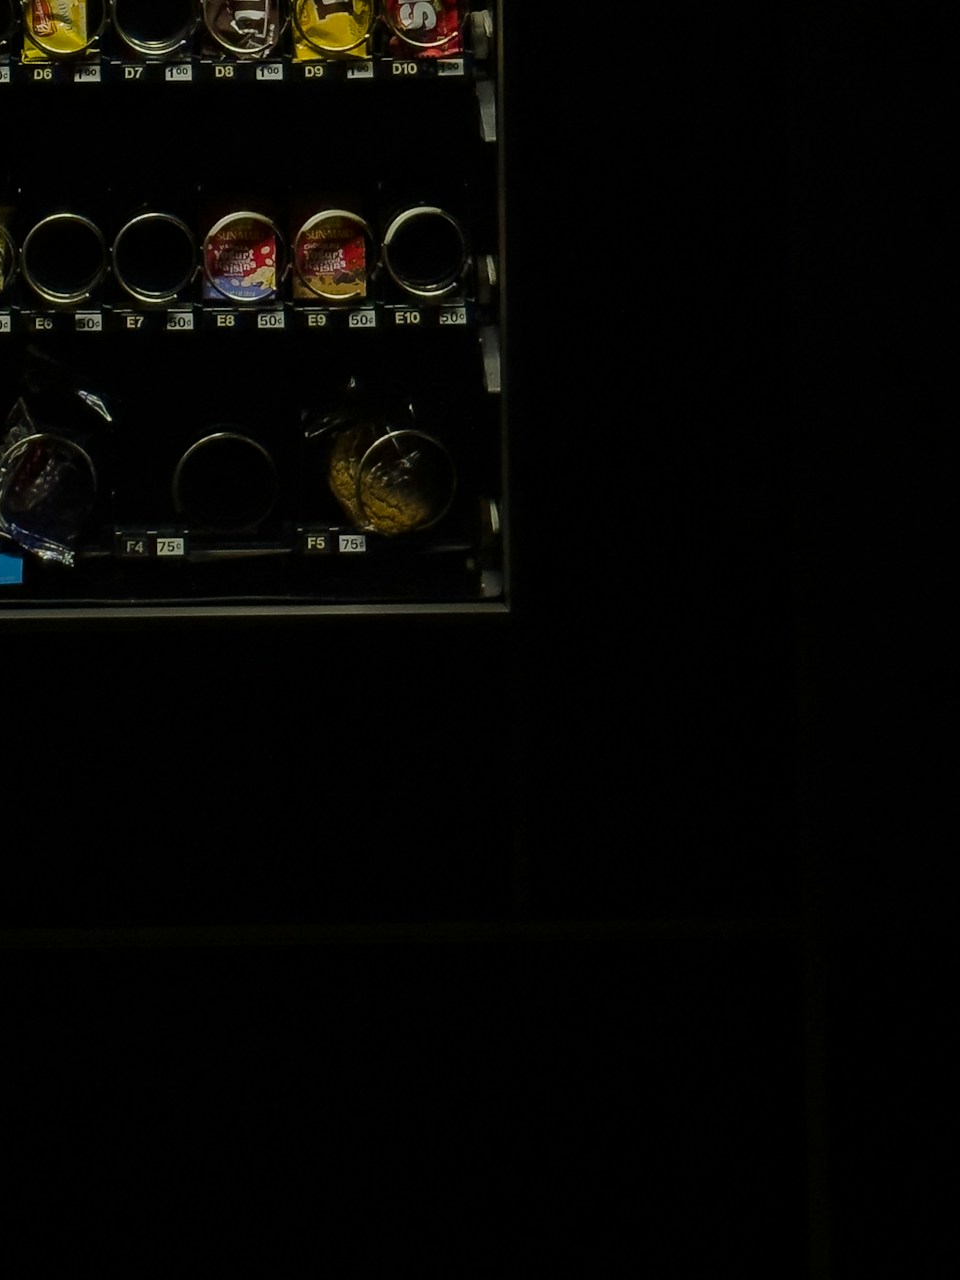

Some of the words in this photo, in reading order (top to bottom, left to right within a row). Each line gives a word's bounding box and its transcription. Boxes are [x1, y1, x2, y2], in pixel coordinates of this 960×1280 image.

[33, 68, 52, 80] D6
[124, 67, 143, 79] D7
[215, 66, 234, 78] D8
[304, 65, 324, 77] D9
[392, 62, 418, 75] D10
[126, 316, 144, 329] E7
[216, 314, 236, 327] E8
[307, 314, 327, 326] E9
[394, 311, 421, 324] E10
[126, 541, 144, 553] F4
[307, 536, 326, 549] F5
